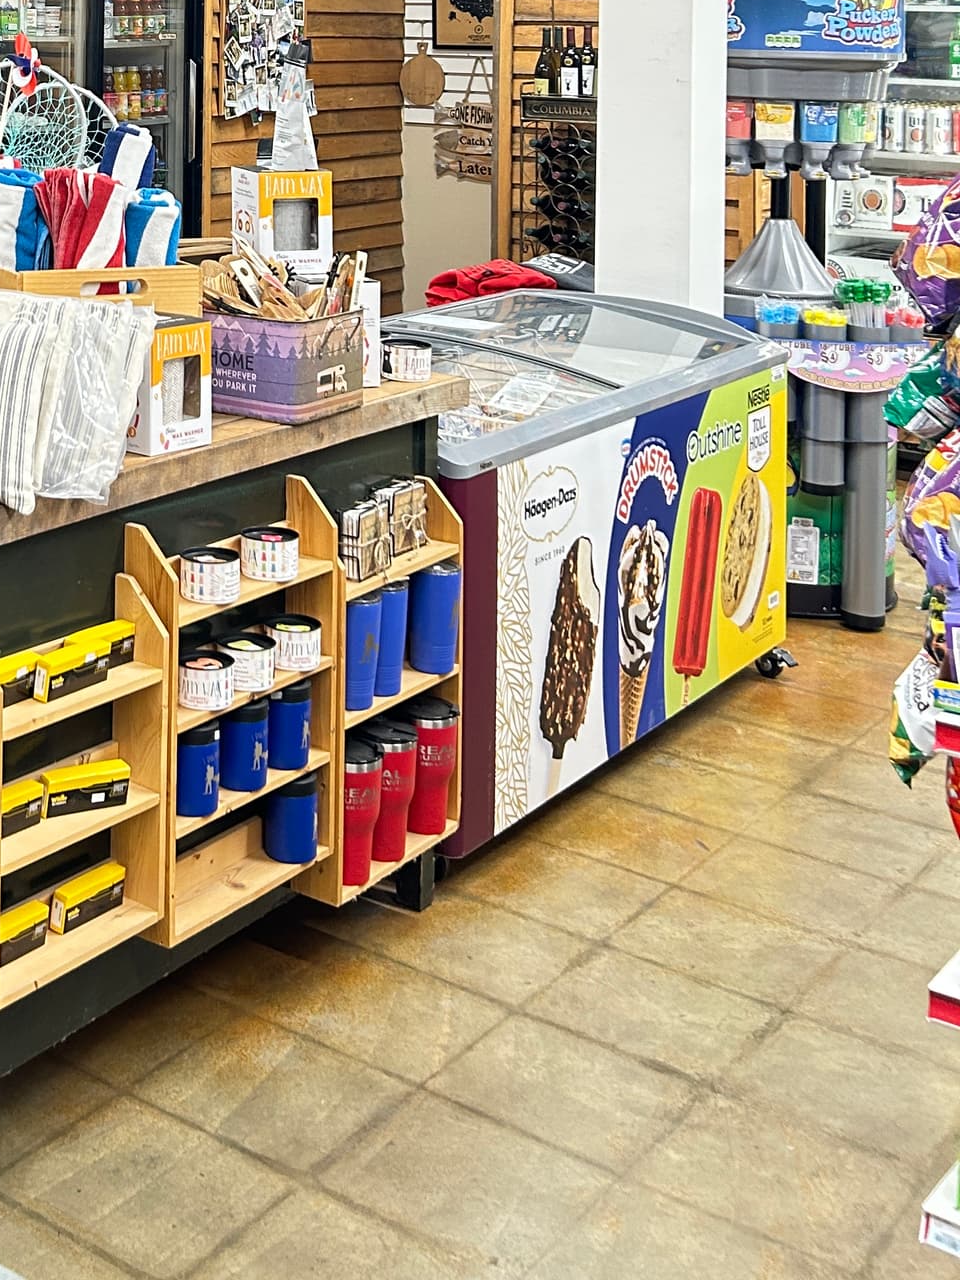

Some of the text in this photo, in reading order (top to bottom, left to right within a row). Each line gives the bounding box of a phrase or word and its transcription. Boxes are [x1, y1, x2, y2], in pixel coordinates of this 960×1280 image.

[450, 105, 470, 121] GONE
[532, 104, 590, 116] COLUMBIA
[459, 135, 486, 146] Catch
[300, 174, 324, 198] WAX
[185, 327, 206, 354] WAX
[833, 343, 856, 352] TUBE
[215, 367, 257, 382] WHEREVER
[212, 378, 257, 394] OU PARK IT
[752, 415, 767, 433] TOLL
[687, 422, 742, 462] Outshine
[749, 431, 769, 451] HOUSE
[534, 552, 552, 566] SINCE
